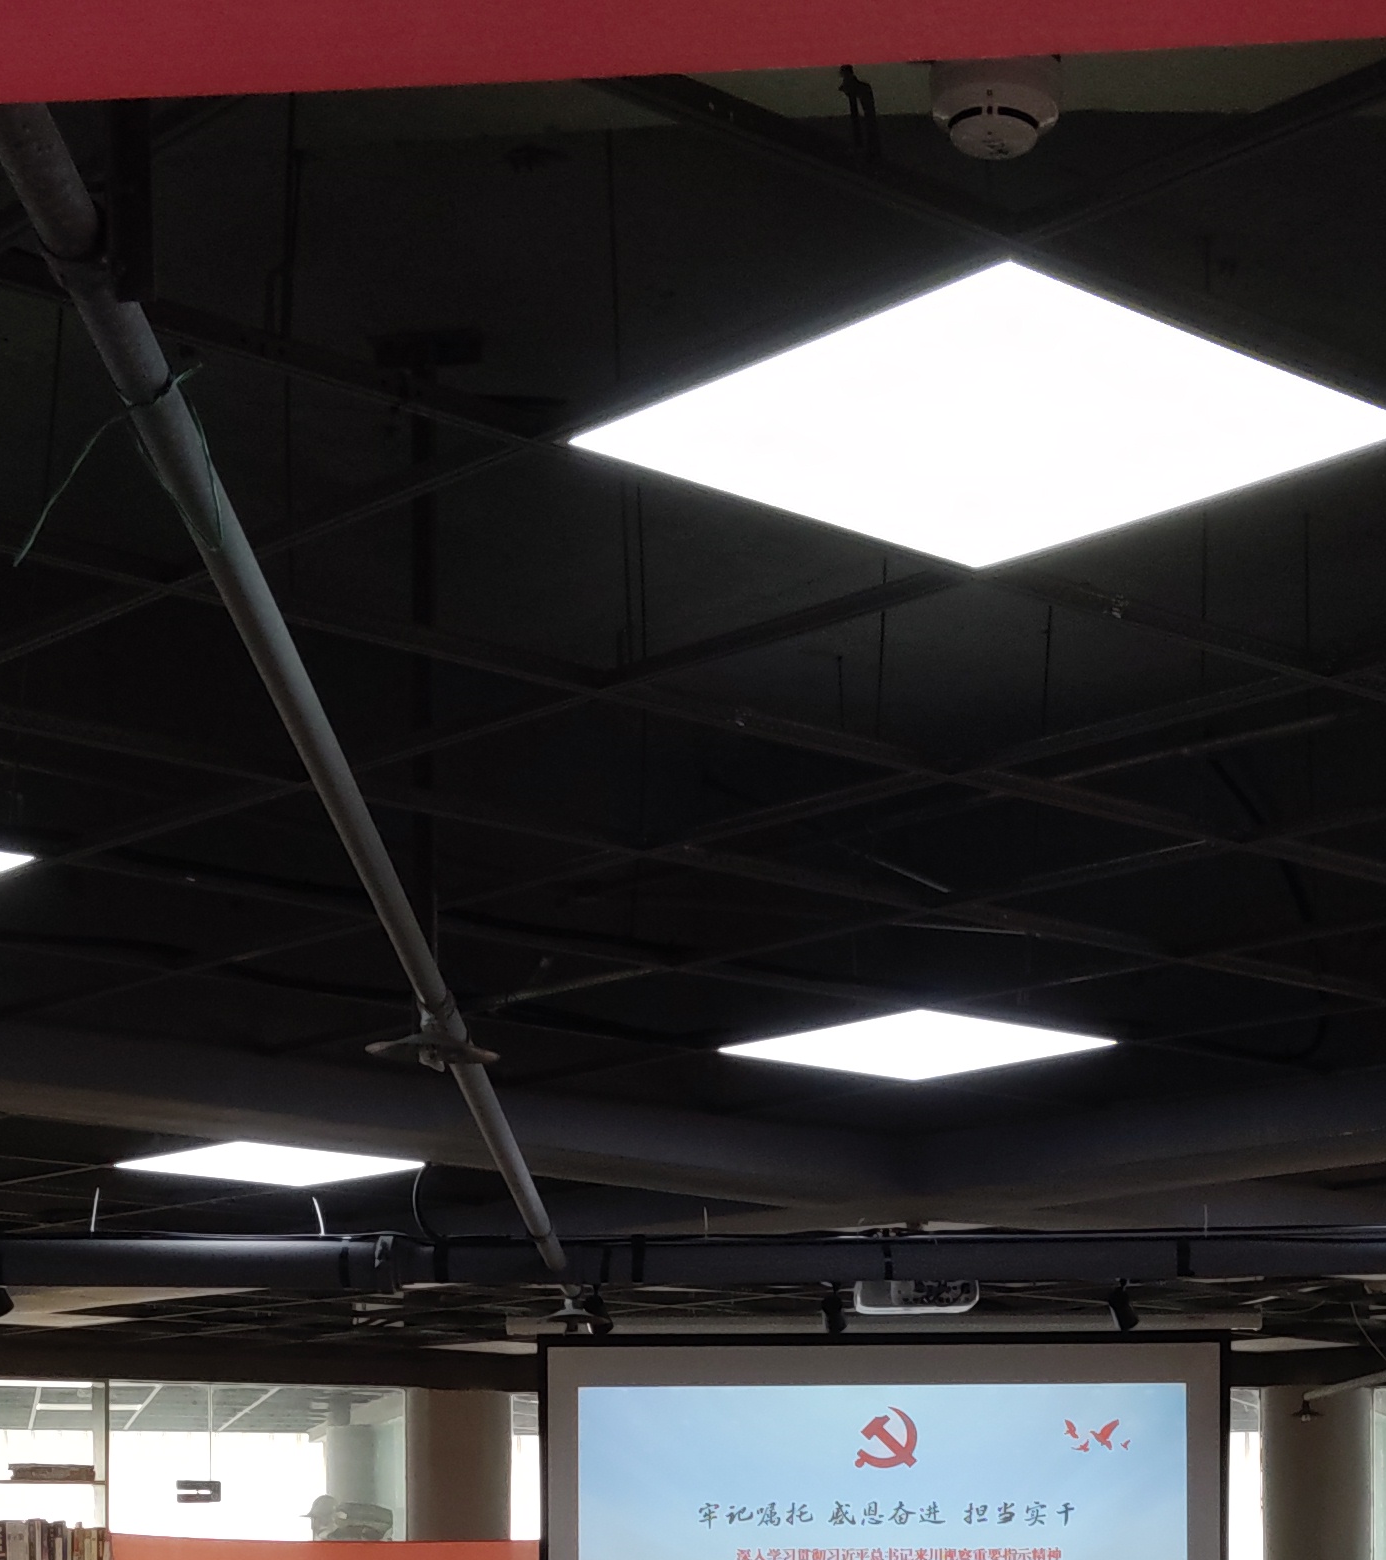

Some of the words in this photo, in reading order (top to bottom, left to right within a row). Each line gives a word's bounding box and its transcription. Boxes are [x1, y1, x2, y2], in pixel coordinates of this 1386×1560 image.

[698, 1501, 814, 1528] 牢记嘱托
[827, 1501, 946, 1527] 感恩奋进
[963, 1501, 1076, 1527] 担当实干
